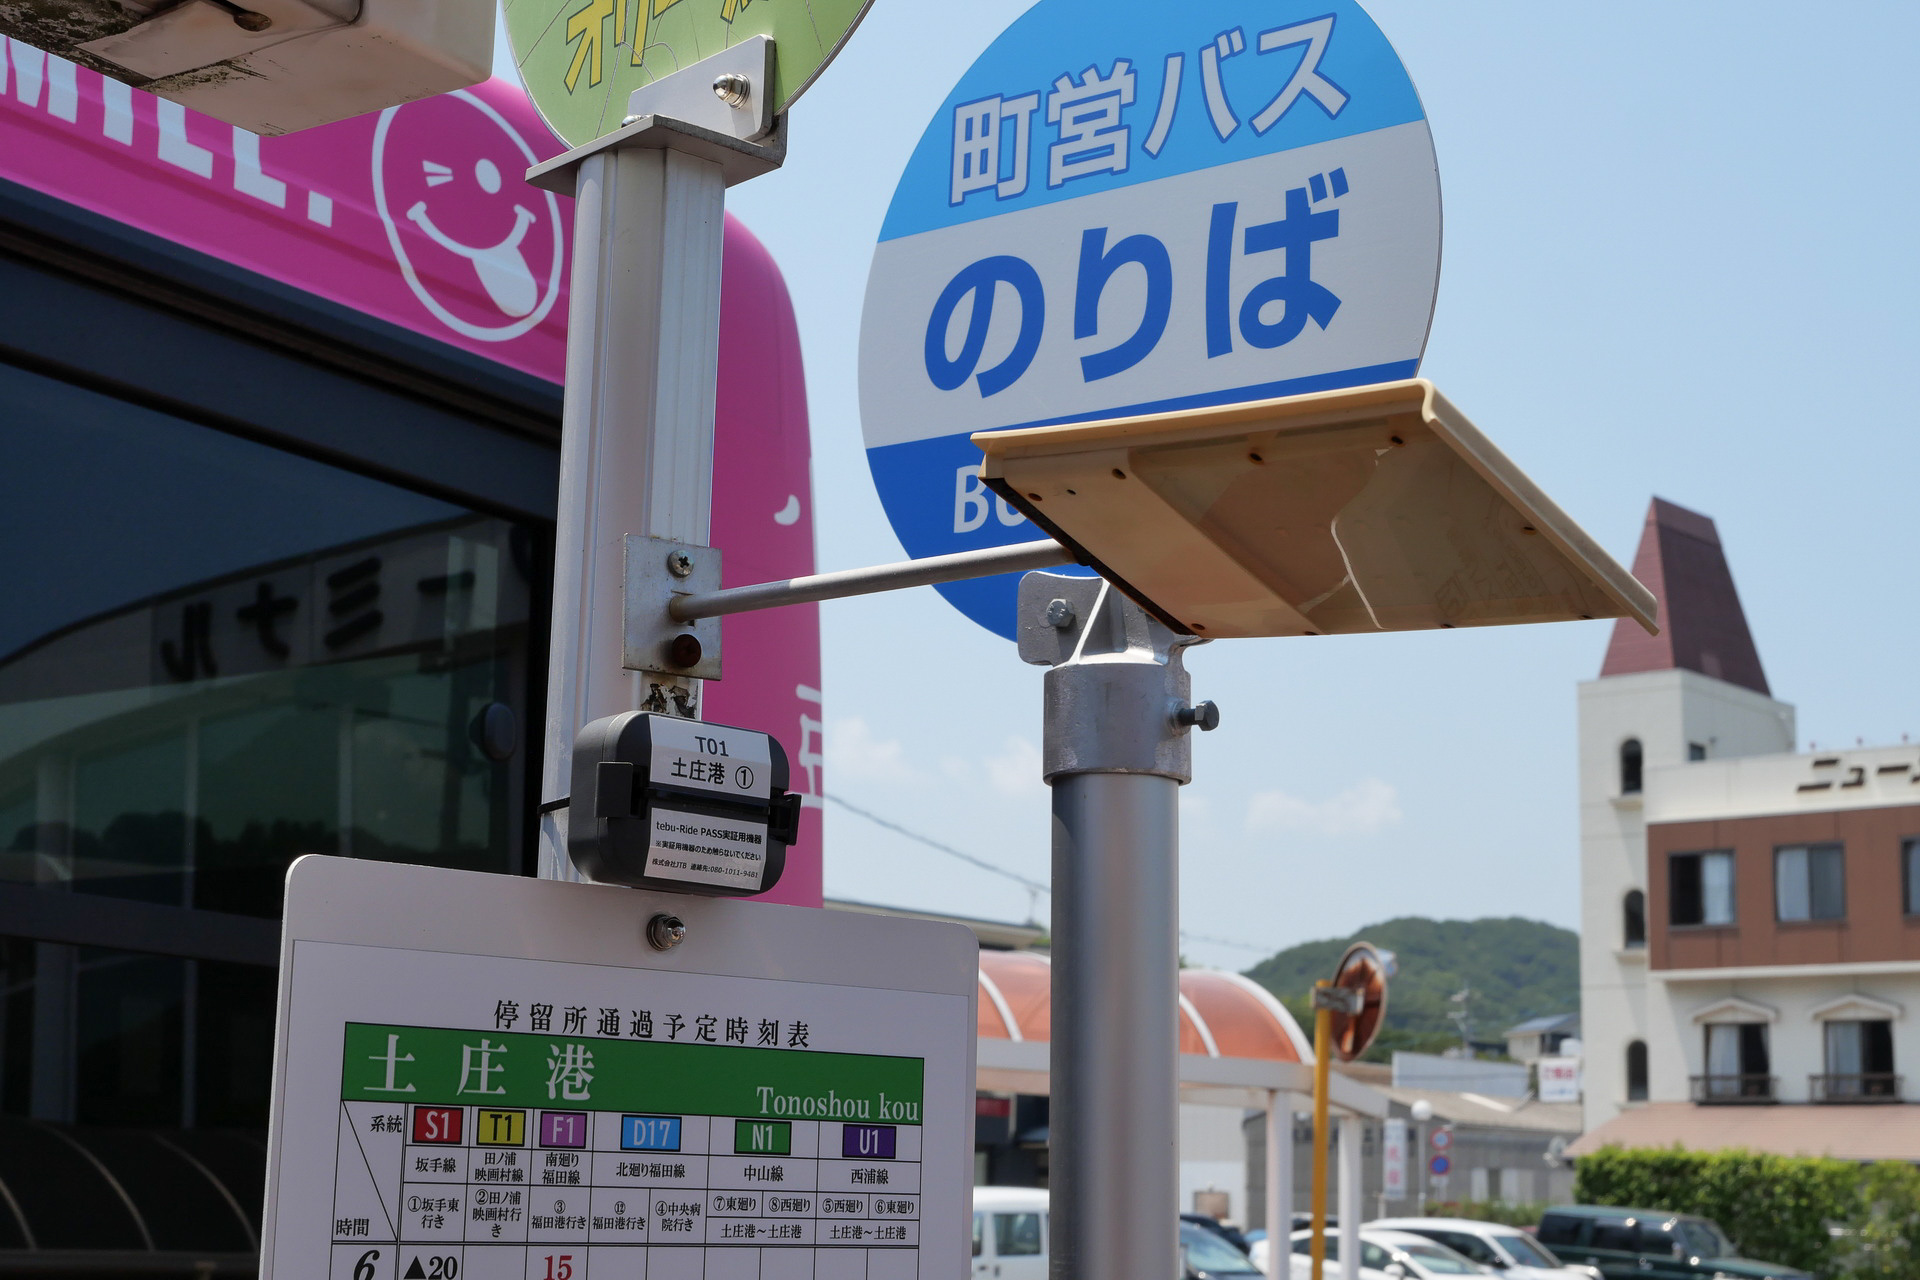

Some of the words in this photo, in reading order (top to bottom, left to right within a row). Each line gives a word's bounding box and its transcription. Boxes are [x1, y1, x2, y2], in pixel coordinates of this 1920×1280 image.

[949, 13, 1350, 207] 町営バス
[925, 167, 1349, 398] のりば
[695, 736, 729, 757] T01
[670, 757, 725, 785] 土庄港
[735, 765, 754, 789] ①
[1797, 758, 1920, 793] ニュー
[656, 821, 699, 836] tebu-Ride
[494, 1000, 810, 1048] 停留所通過予定時刻表
[363, 1034, 595, 1100] 土庄港
[756, 1086, 870, 1119] Tonoshou
[878, 1092, 919, 1121] kou
[370, 1115, 403, 1133] 系統
[425, 1111, 450, 1140] S1
[490, 1114, 512, 1142] T1
[552, 1116, 574, 1144] F1
[633, 1119, 671, 1147] D17
[752, 1124, 773, 1151] N1
[859, 1129, 879, 1155] U1
[415, 1157, 456, 1173] 坂手線
[484, 1152, 517, 1166] 田ノ浦
[545, 1152, 579, 1167] 南廻り
[475, 1167, 523, 1182] 映画村線
[542, 1169, 580, 1184] 福田線
[616, 1162, 685, 1178] 北廻り福田線
[743, 1164, 784, 1182] 中山線
[851, 1168, 889, 1185] 西浦線
[472, 1207, 522, 1221] 映画村行
[553, 1199, 566, 1214] ③
[335, 1218, 370, 1236] 時間
[421, 1214, 445, 1229] 行き
[491, 1223, 502, 1238] き
[531, 1215, 587, 1229] 福田港行き
[592, 1216, 646, 1230] 福田港行き
[661, 1218, 694, 1231] 院行き
[353, 1250, 380, 1280] 6
[428, 1256, 458, 1280] 20
[543, 1255, 573, 1280] 15
